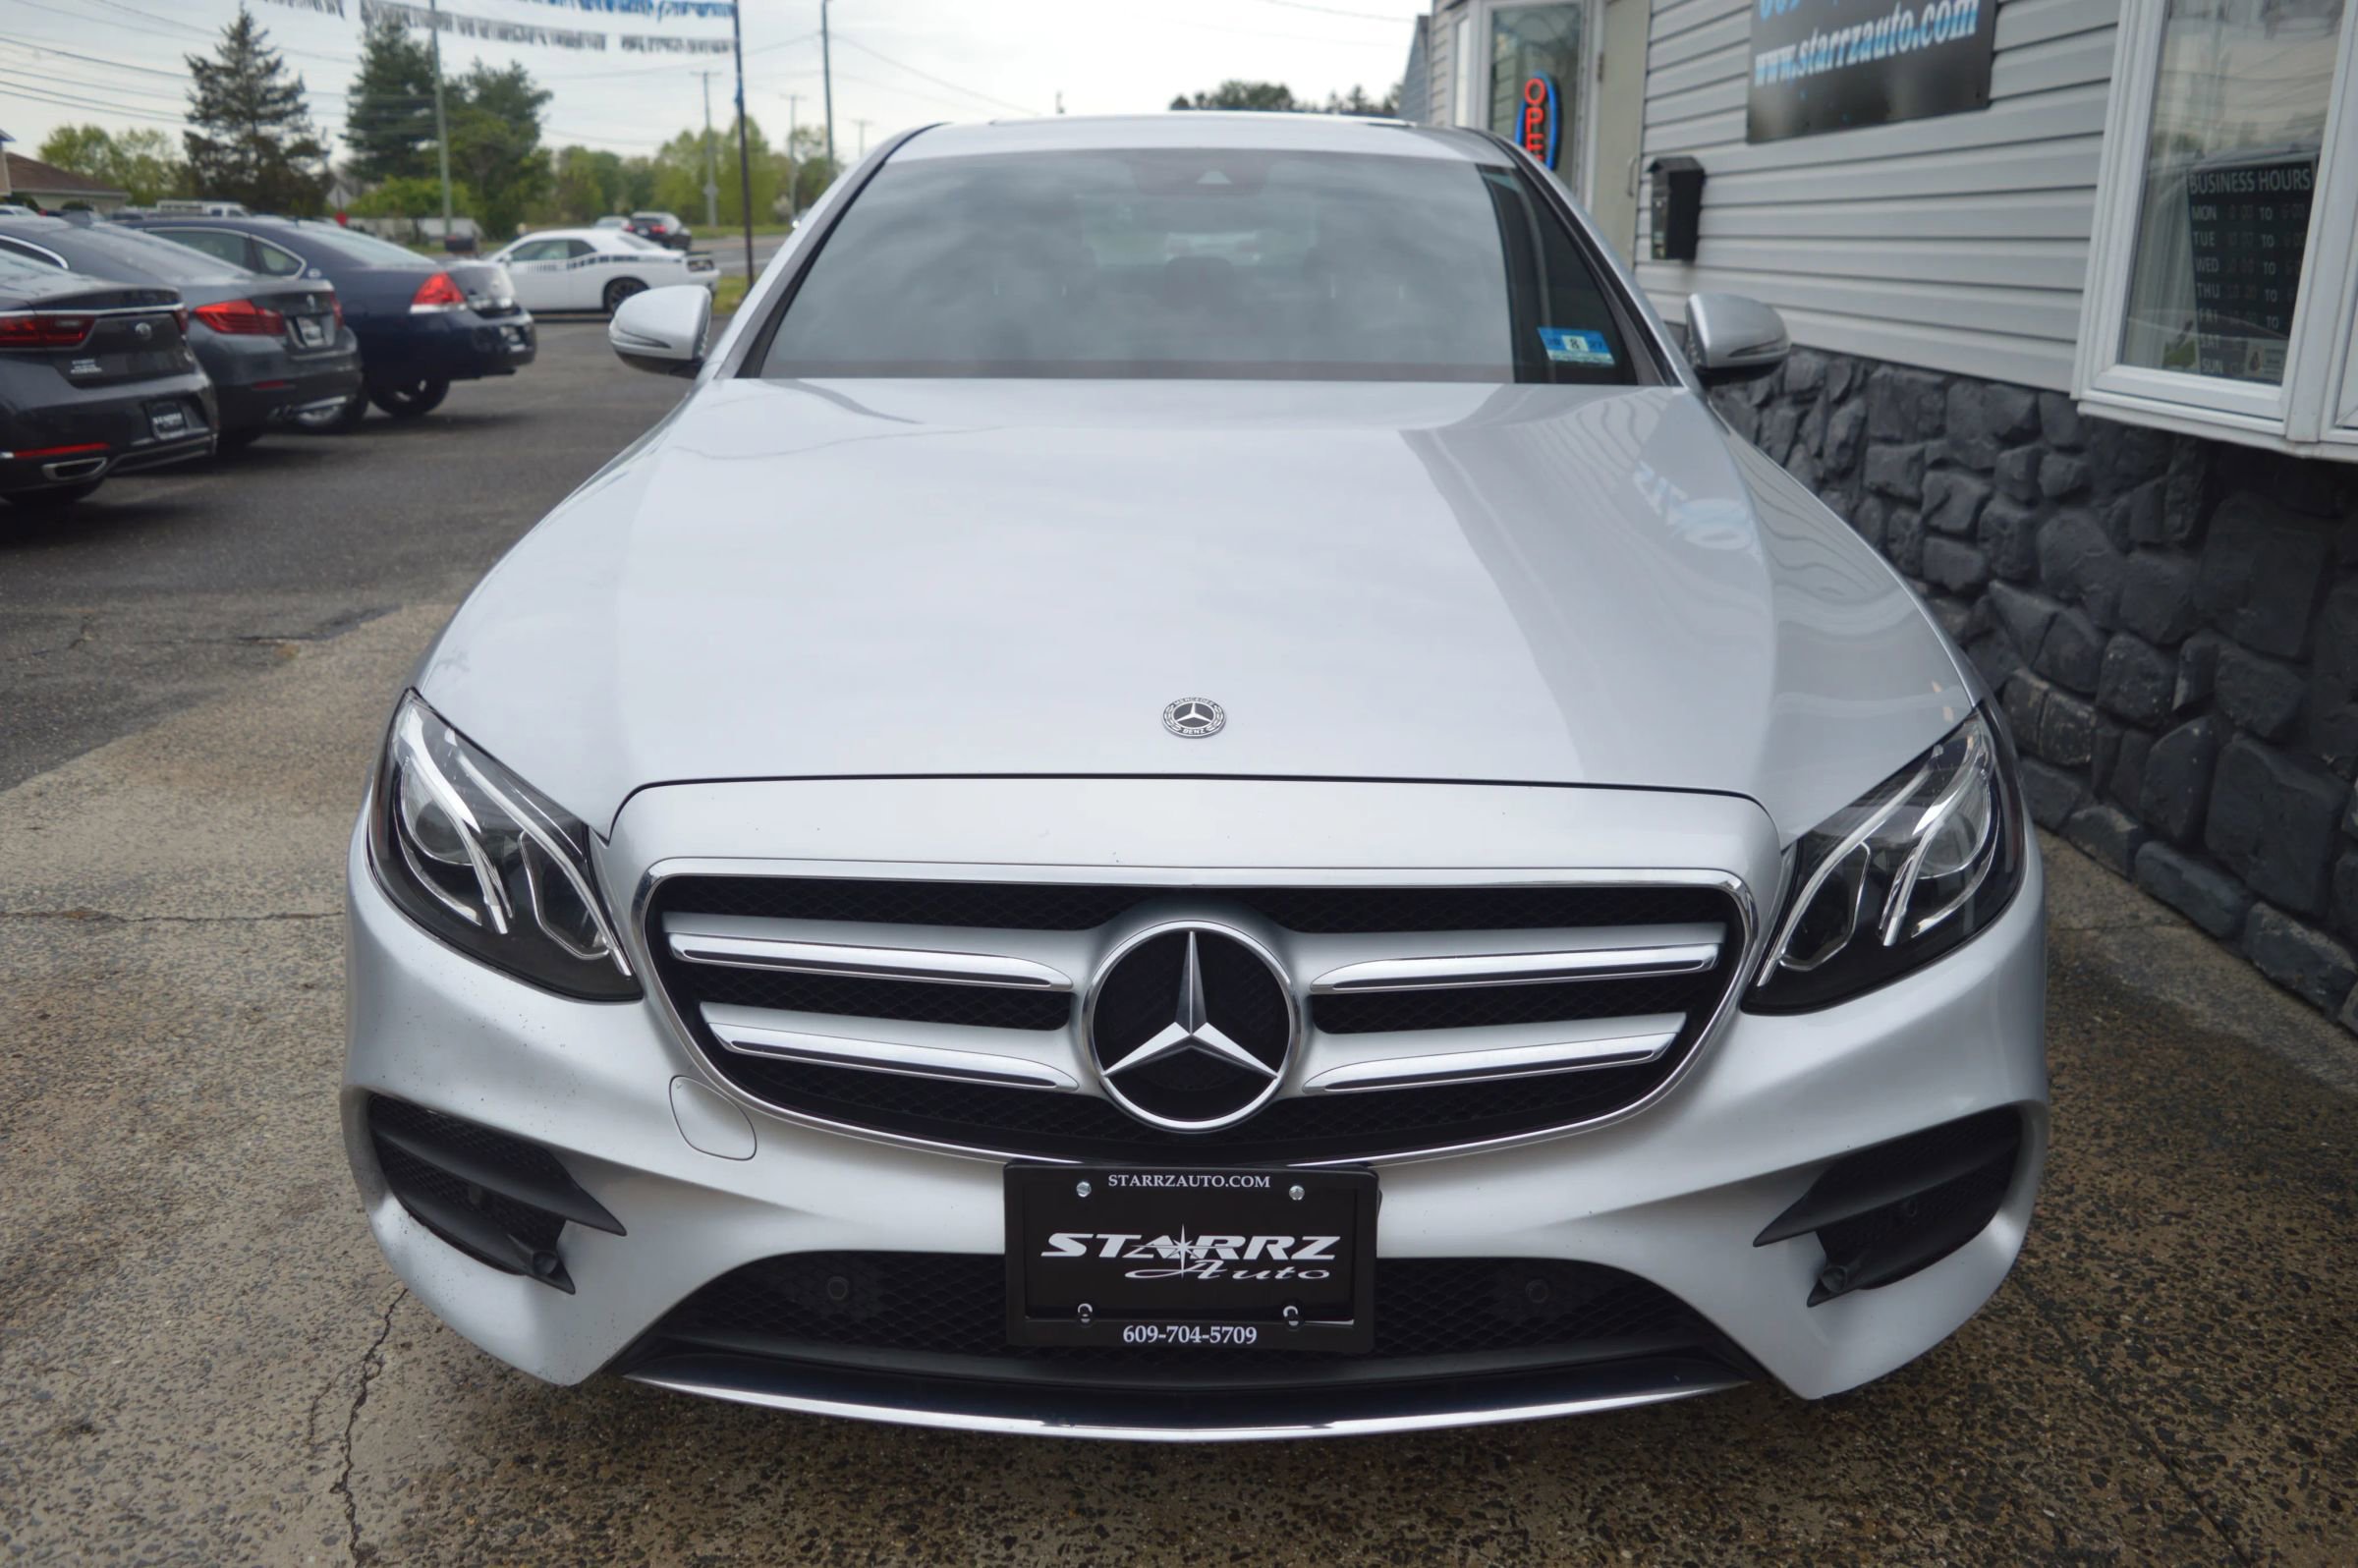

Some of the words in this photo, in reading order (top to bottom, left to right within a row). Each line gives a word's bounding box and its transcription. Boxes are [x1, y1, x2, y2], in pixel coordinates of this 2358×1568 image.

[1755, 0, 1979, 86] www.starrzauto.com
[1524, 78, 1546, 162] OPE
[2189, 171, 2256, 195] BUSINESS
[2258, 168, 2312, 192] HOURS
[2192, 204, 2218, 221] MON
[2259, 206, 2274, 221] TO
[2193, 231, 2217, 247] TUE
[2261, 234, 2275, 249] TO
[2194, 256, 2219, 273] WED
[2263, 260, 2277, 276] TO
[2196, 282, 2220, 299] THU
[2264, 288, 2278, 304] TO
[2266, 315, 2279, 330] TO
[1107, 1174, 1270, 1189] STARRZAUTO.COM
[1040, 1232, 1340, 1260] STARRZ
[1124, 1259, 1330, 1280] Auto
[1122, 1324, 1258, 1344] 609-704-5709
